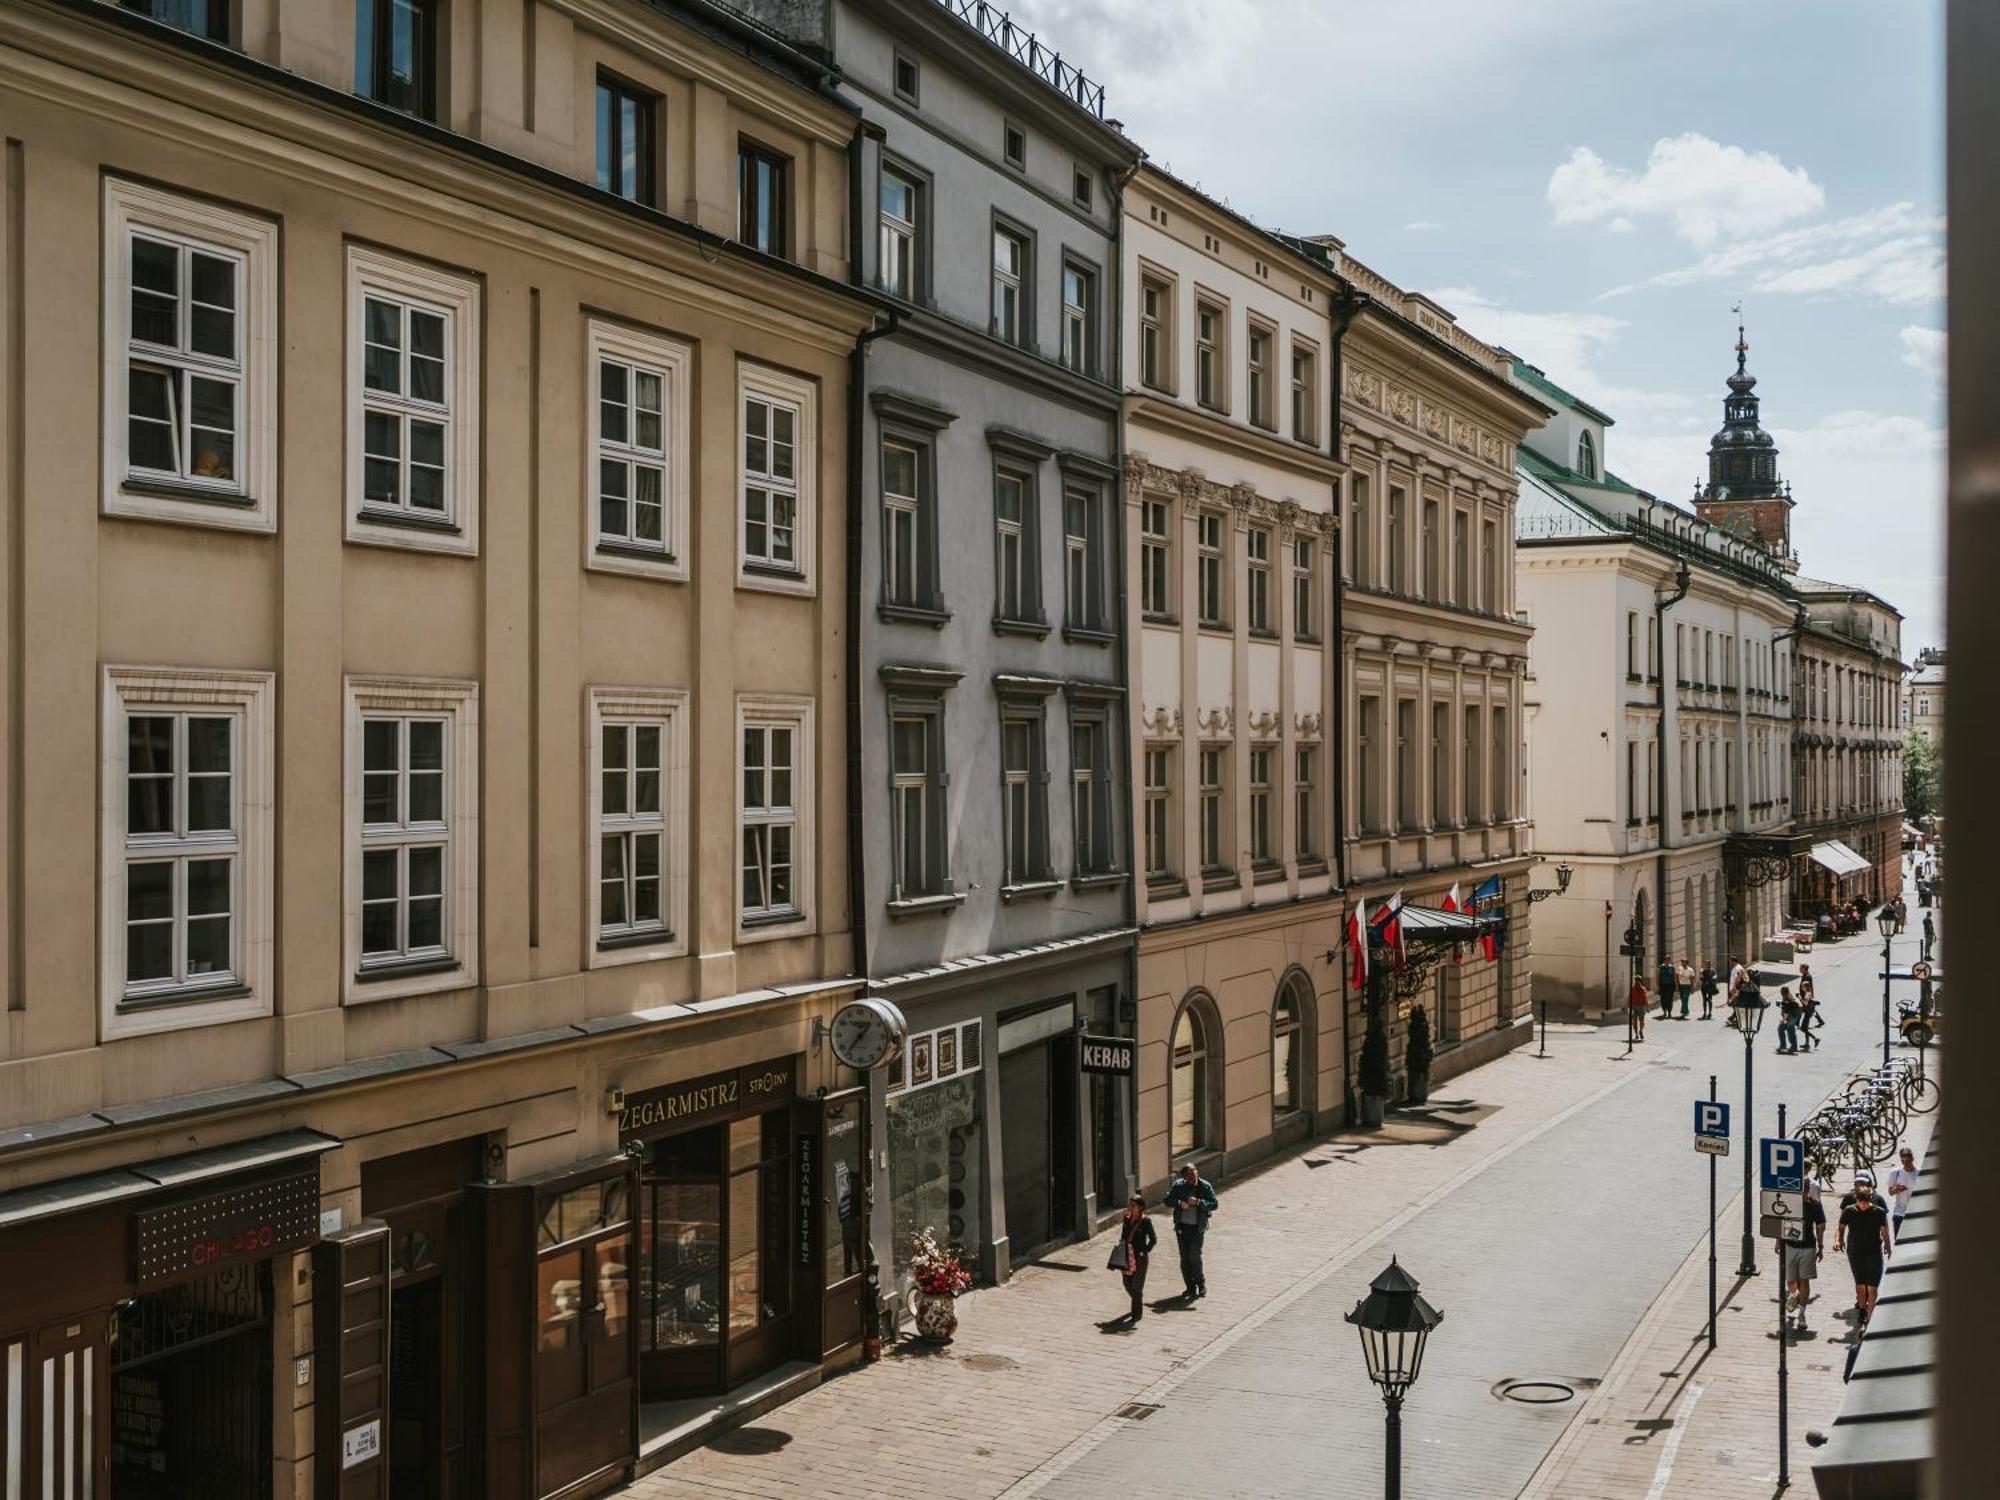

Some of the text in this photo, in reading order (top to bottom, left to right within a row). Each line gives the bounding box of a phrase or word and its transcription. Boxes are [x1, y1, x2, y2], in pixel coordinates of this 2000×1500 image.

[1083, 1045, 1131, 1069] KEBAB
[619, 1080, 739, 1132] ZEGARMISTRZ
[1702, 1105, 1722, 1131] P
[1770, 1143, 1795, 1176] P
